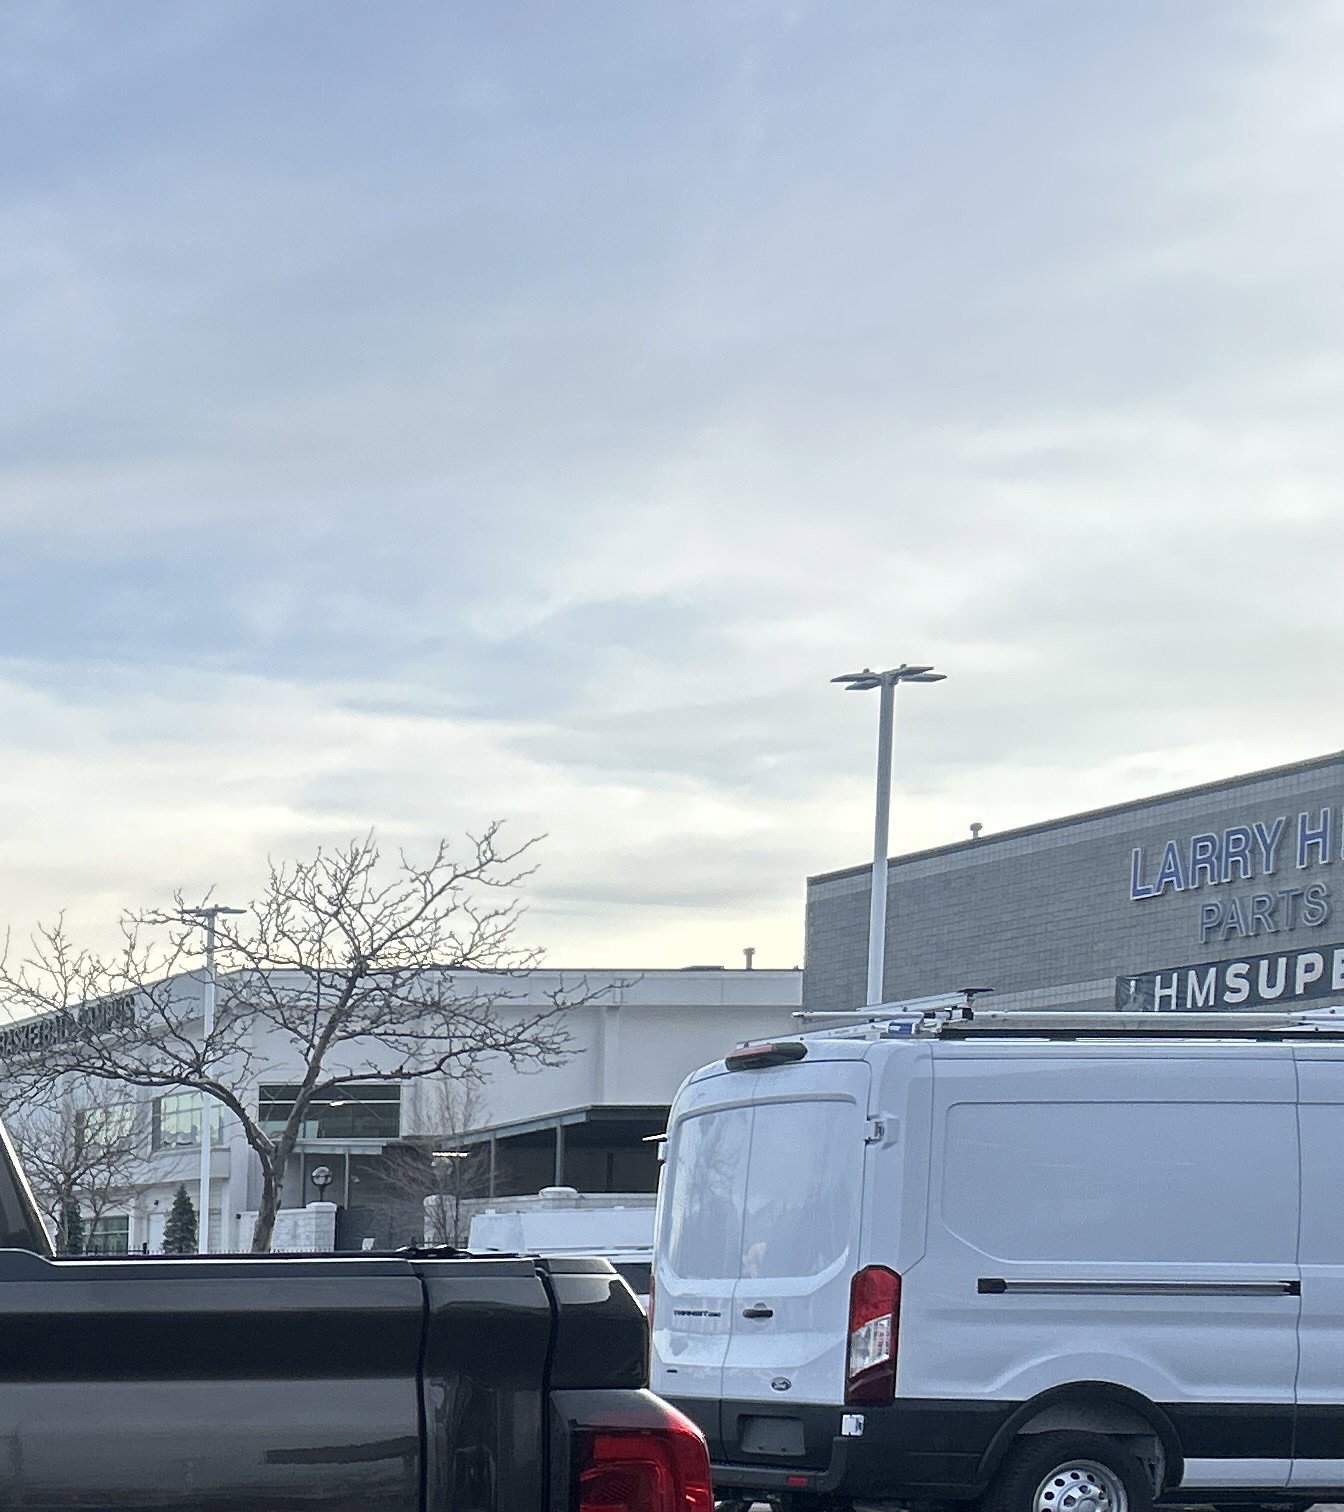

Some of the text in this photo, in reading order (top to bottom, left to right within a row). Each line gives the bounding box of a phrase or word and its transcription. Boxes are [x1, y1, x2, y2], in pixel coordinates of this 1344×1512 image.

[1130, 807, 1331, 900] LARRY H
[1199, 882, 1329, 944] PARTS
